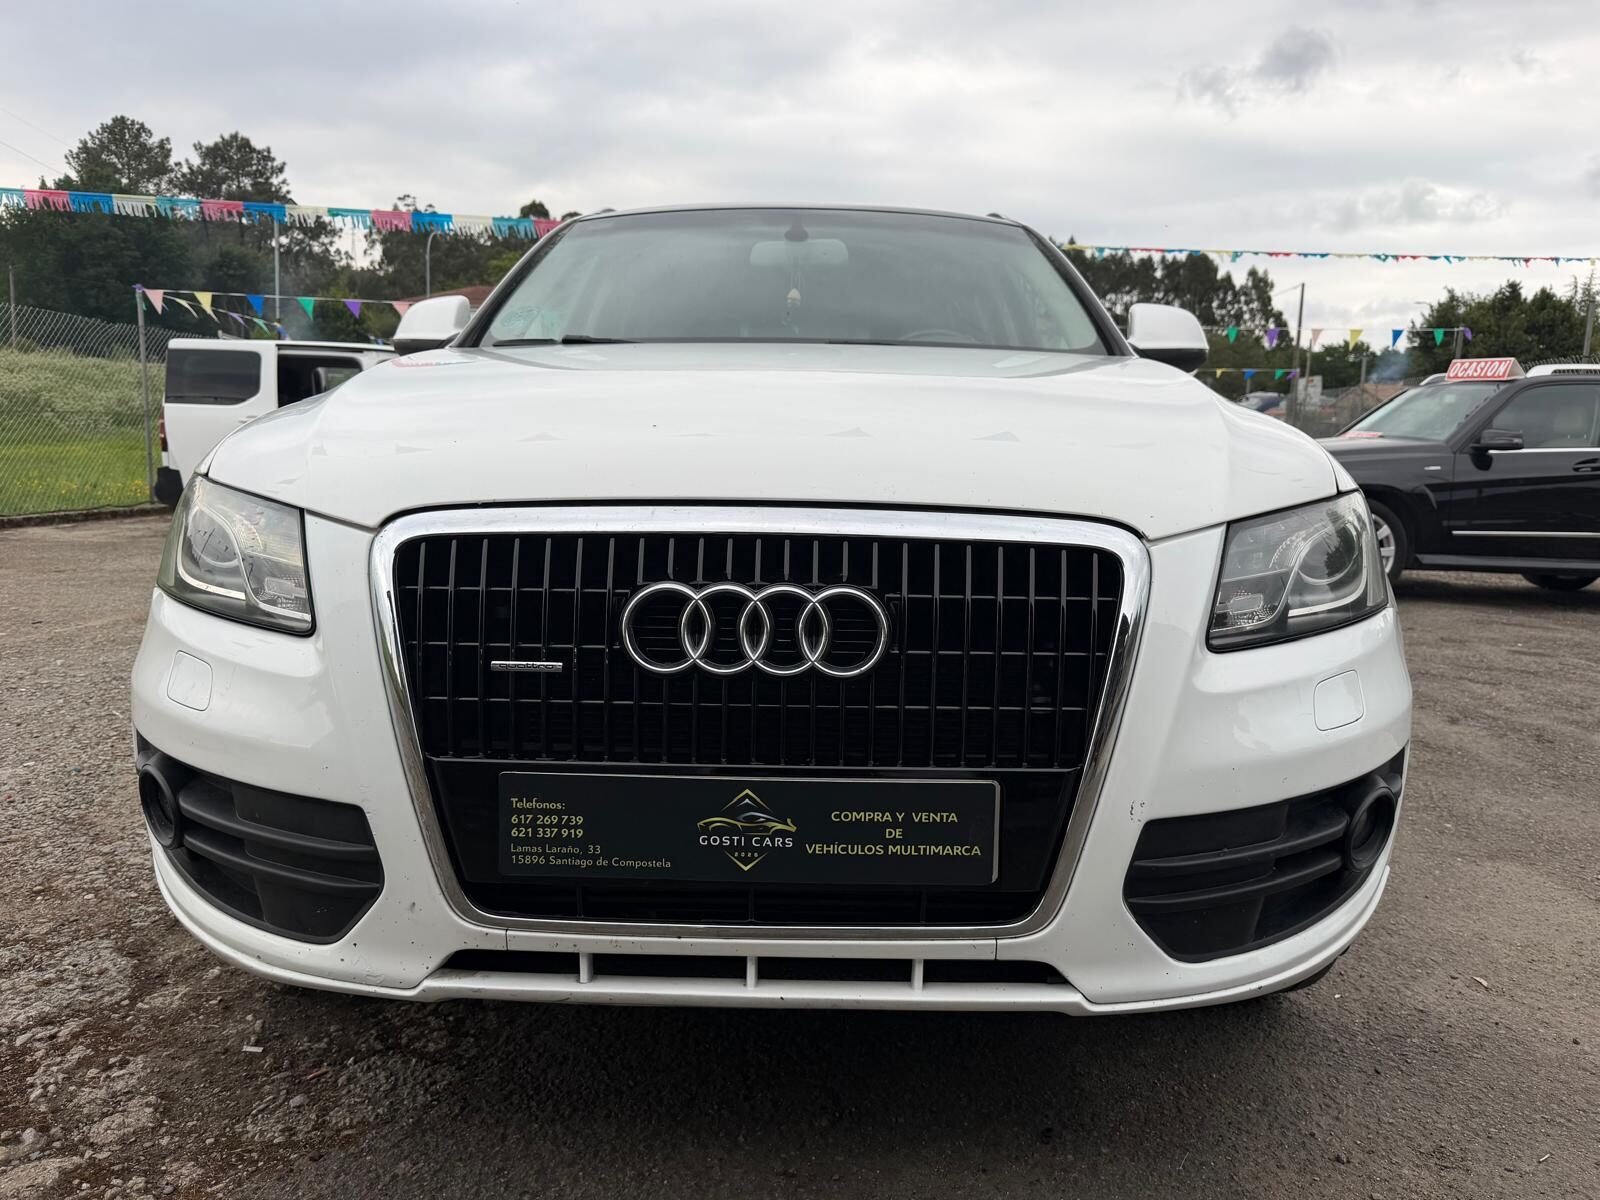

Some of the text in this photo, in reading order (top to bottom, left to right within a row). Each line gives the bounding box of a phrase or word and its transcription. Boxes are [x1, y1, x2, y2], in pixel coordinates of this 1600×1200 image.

[1449, 360, 1509, 377] OCASION
[510, 797, 566, 810] Telefonos:
[511, 814, 584, 825] 617 269 739
[831, 811, 958, 823] COMPRA Y VENTA
[511, 827, 584, 839] 621 337 919
[885, 828, 903, 839] DE
[699, 835, 793, 848] GOSTI CARS
[510, 843, 601, 855] Lamas Laraño, 33
[806, 841, 982, 856] VEHÍCULOS MULTIMARCA
[511, 855, 671, 869] 15896 Santiago de Compostela
